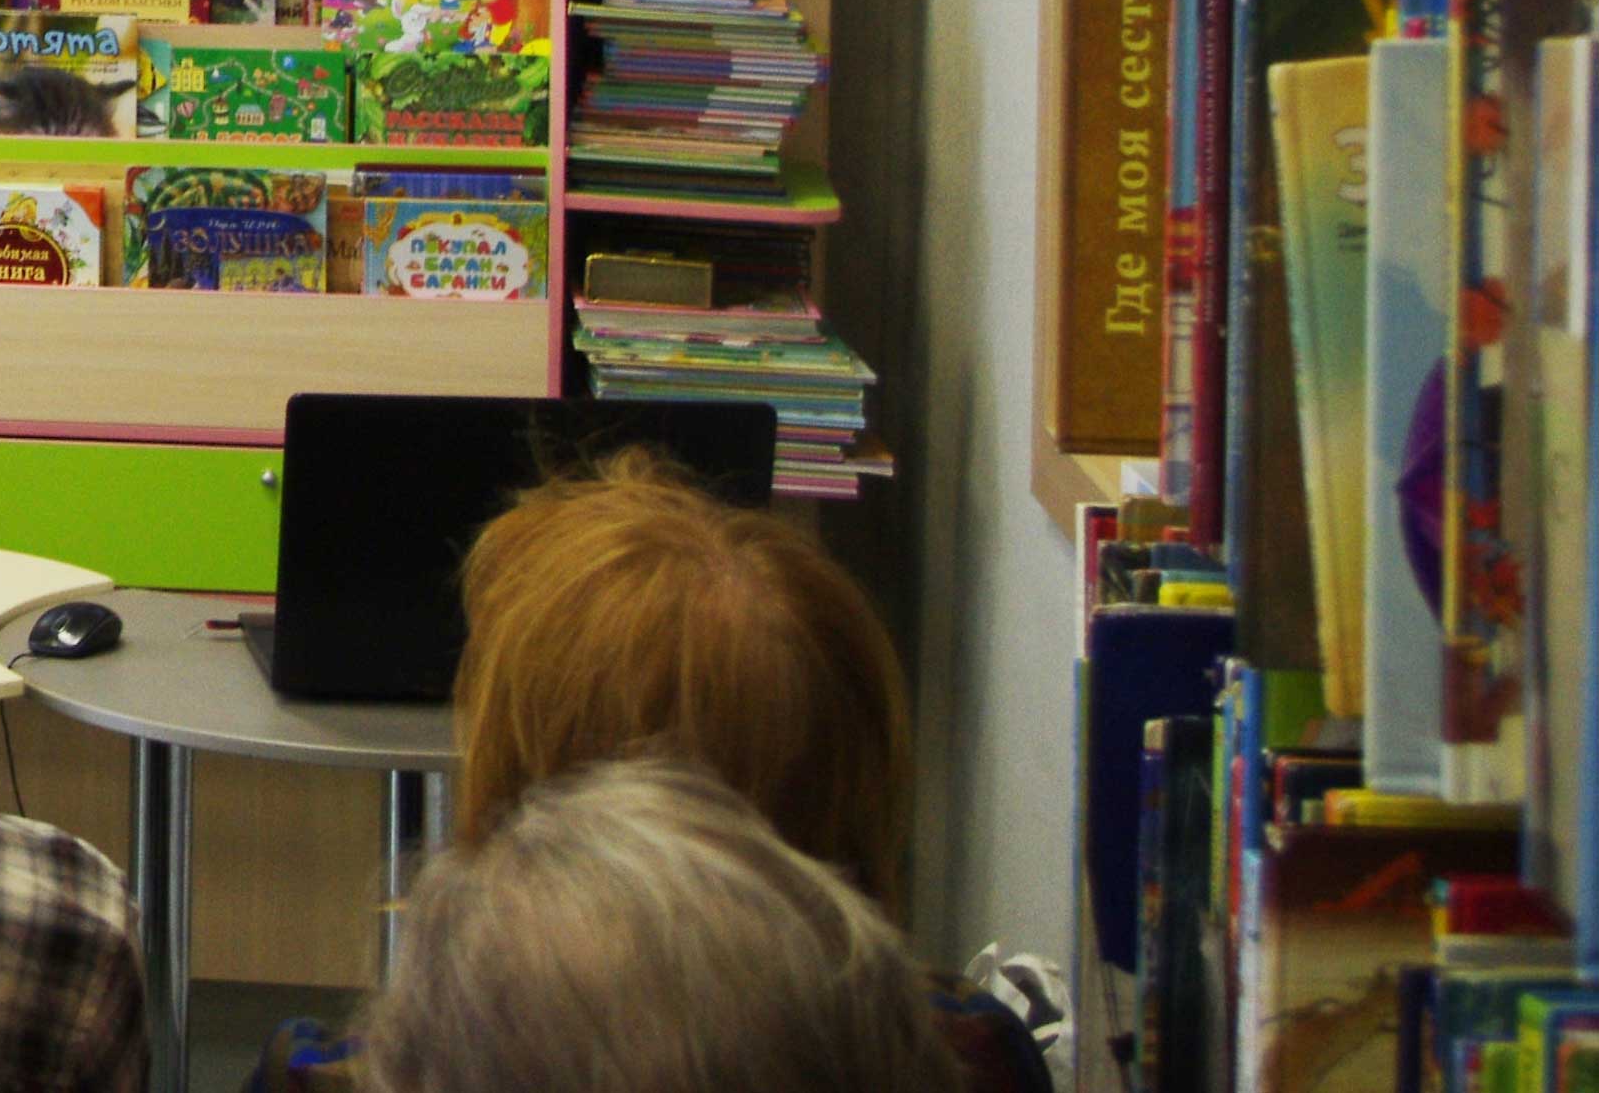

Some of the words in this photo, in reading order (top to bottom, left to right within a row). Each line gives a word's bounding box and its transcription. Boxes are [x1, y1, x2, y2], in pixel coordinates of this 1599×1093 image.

[1118, 128, 1149, 234] моя
[411, 239, 507, 255] ПОКУПАЛ
[424, 257, 493, 272] БАРАН
[410, 274, 506, 290] БАРАНКИ
[1105, 251, 1154, 336] Где
